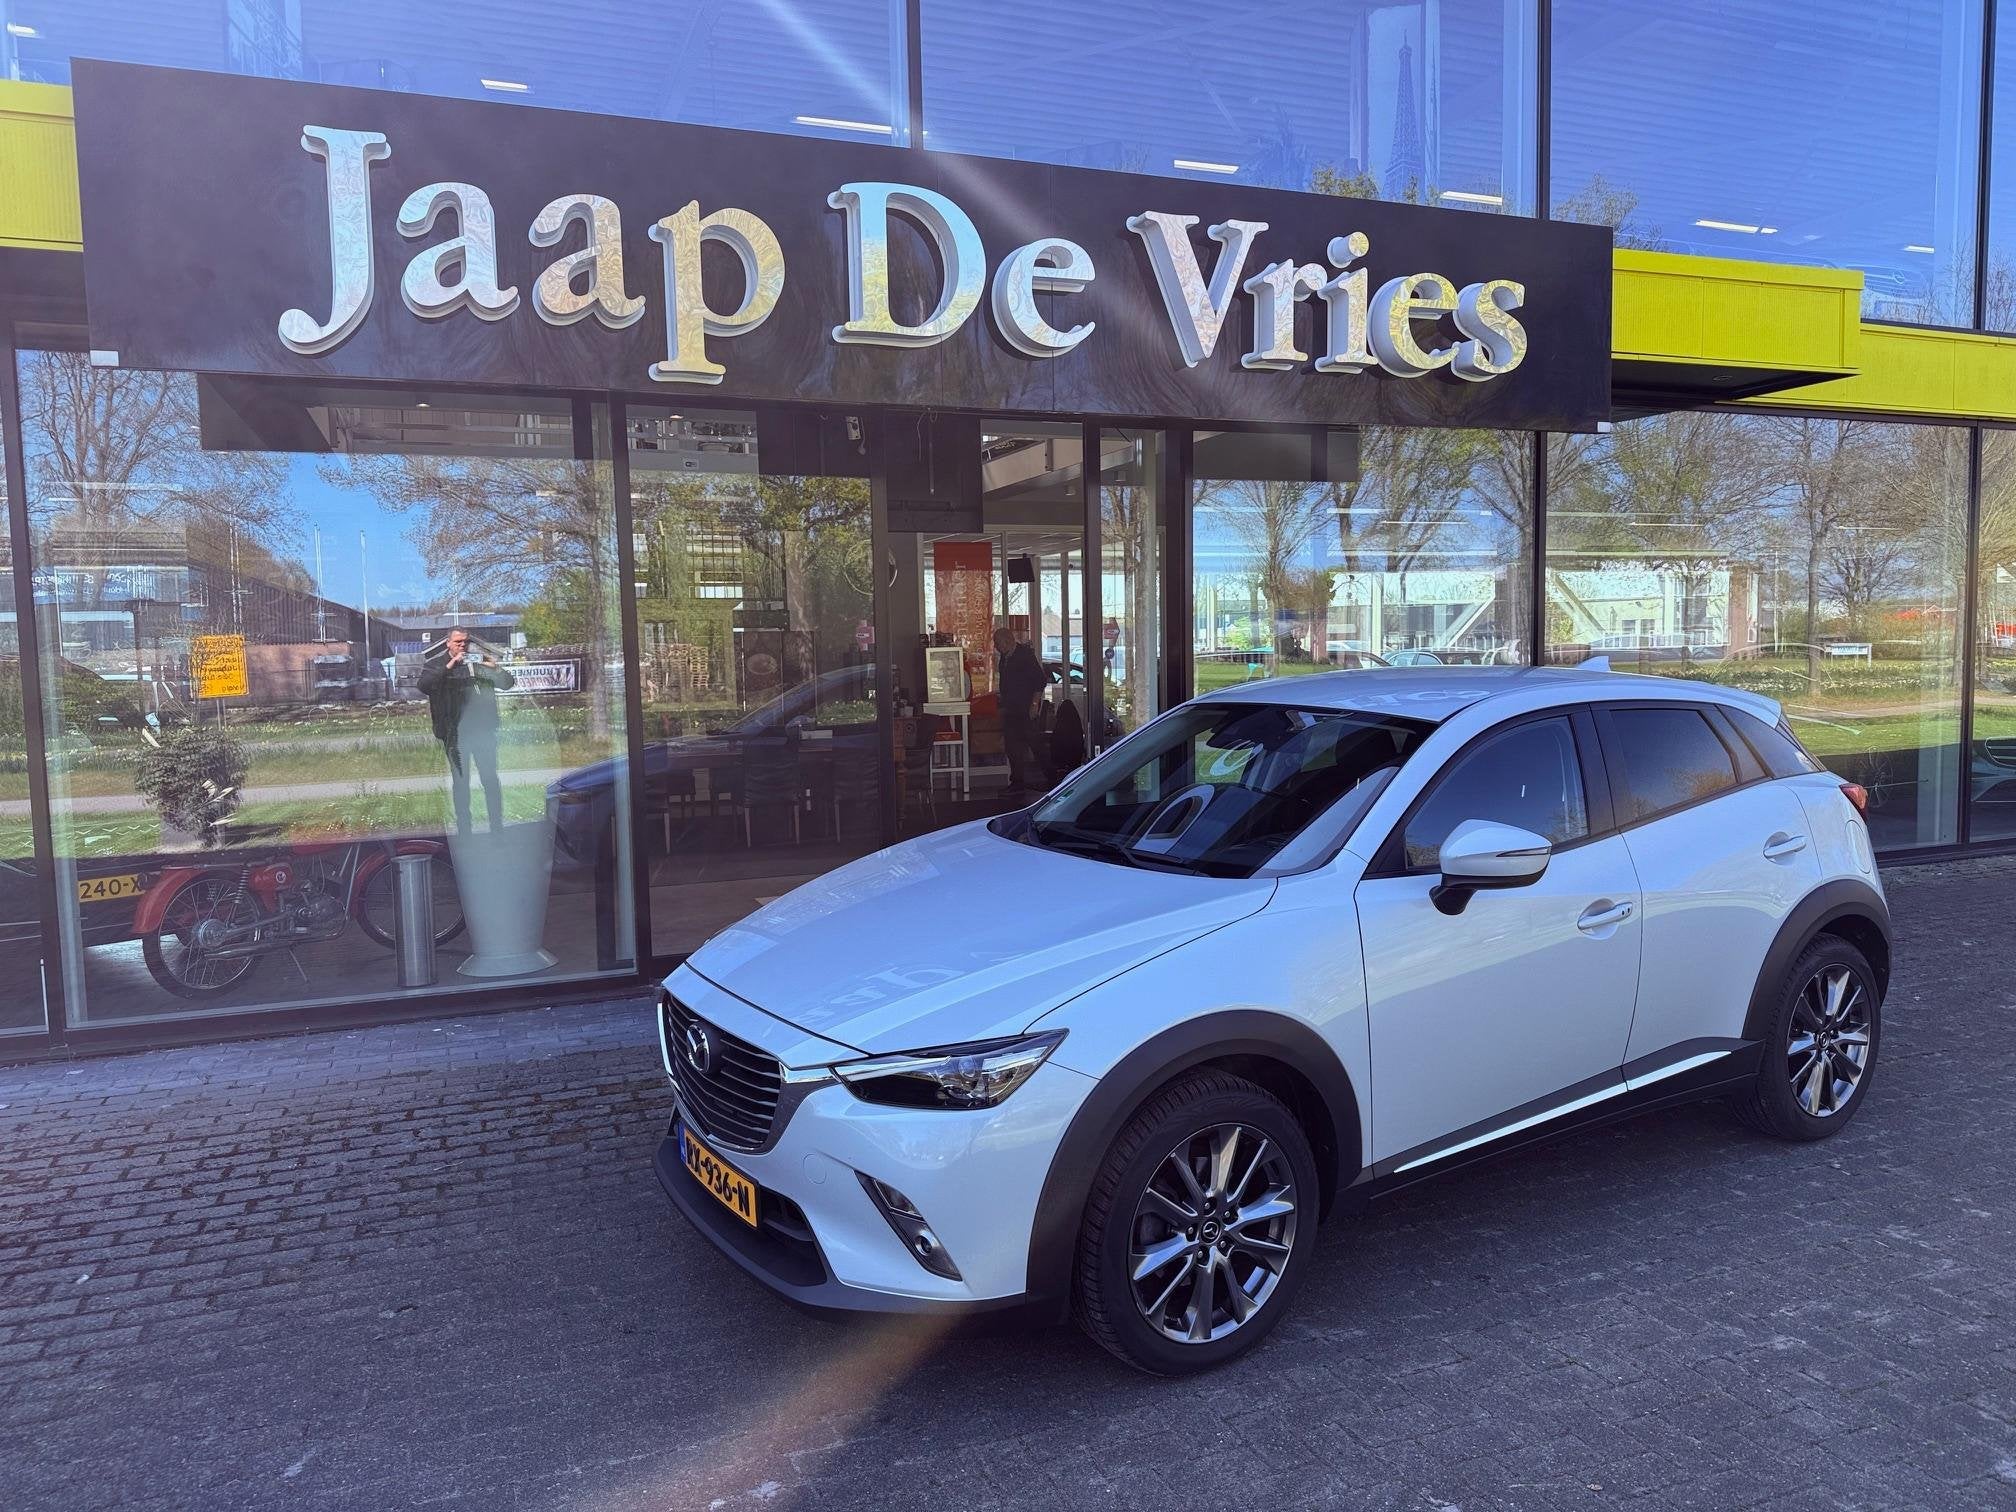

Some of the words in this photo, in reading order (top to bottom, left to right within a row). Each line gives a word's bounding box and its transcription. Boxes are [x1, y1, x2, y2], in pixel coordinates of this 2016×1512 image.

[278, 124, 786, 384] Jaap
[827, 181, 1097, 359] De
[1126, 209, 1527, 382] Vries
[952, 561, 968, 650] ntander
